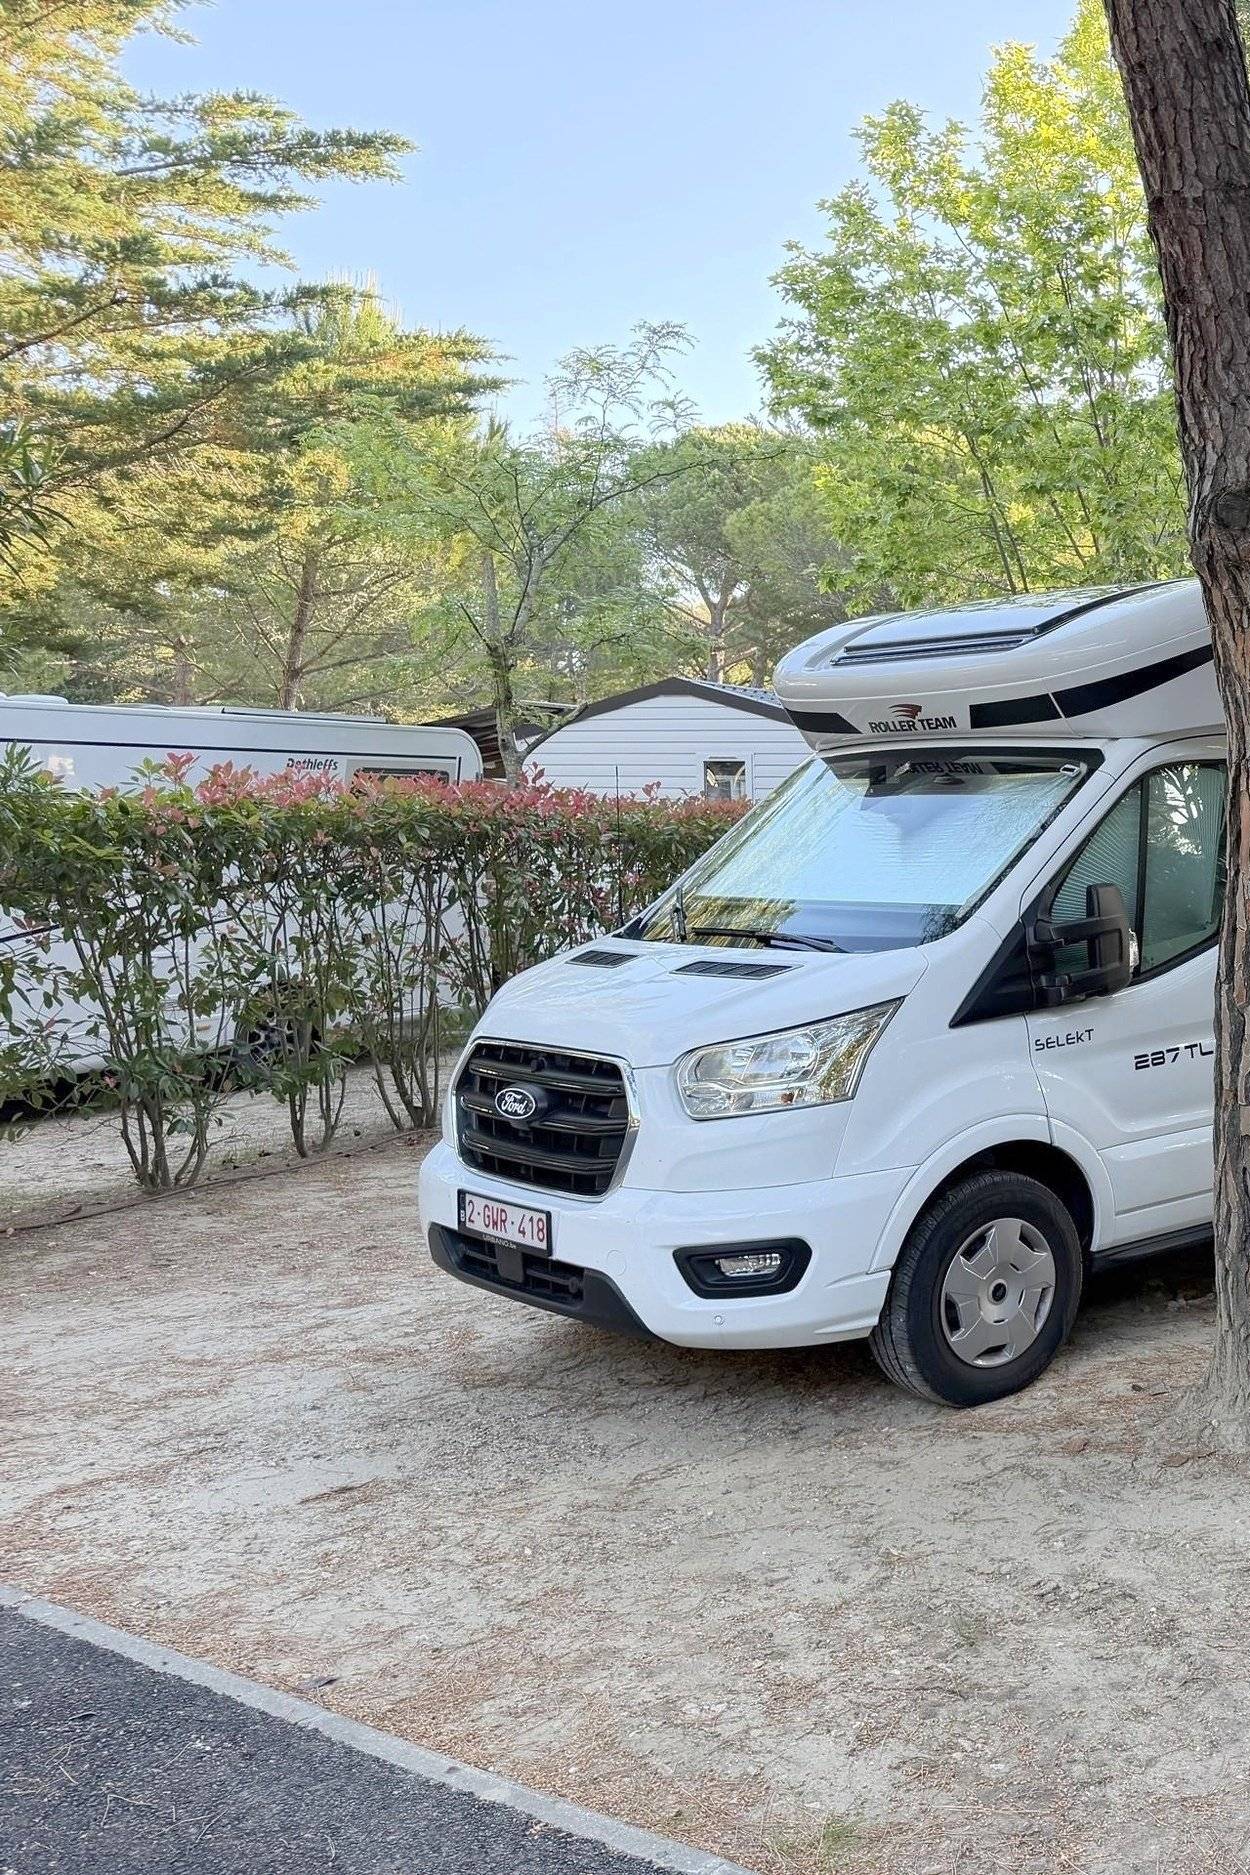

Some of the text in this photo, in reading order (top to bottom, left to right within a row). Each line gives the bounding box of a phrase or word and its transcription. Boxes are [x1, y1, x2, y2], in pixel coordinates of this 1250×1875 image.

[868, 716, 957, 734] ROLLER TEAM
[1034, 1028, 1095, 1051] SELEKT
[1133, 1042, 1214, 1070] 287 TL
[500, 1091, 528, 1115] Ford
